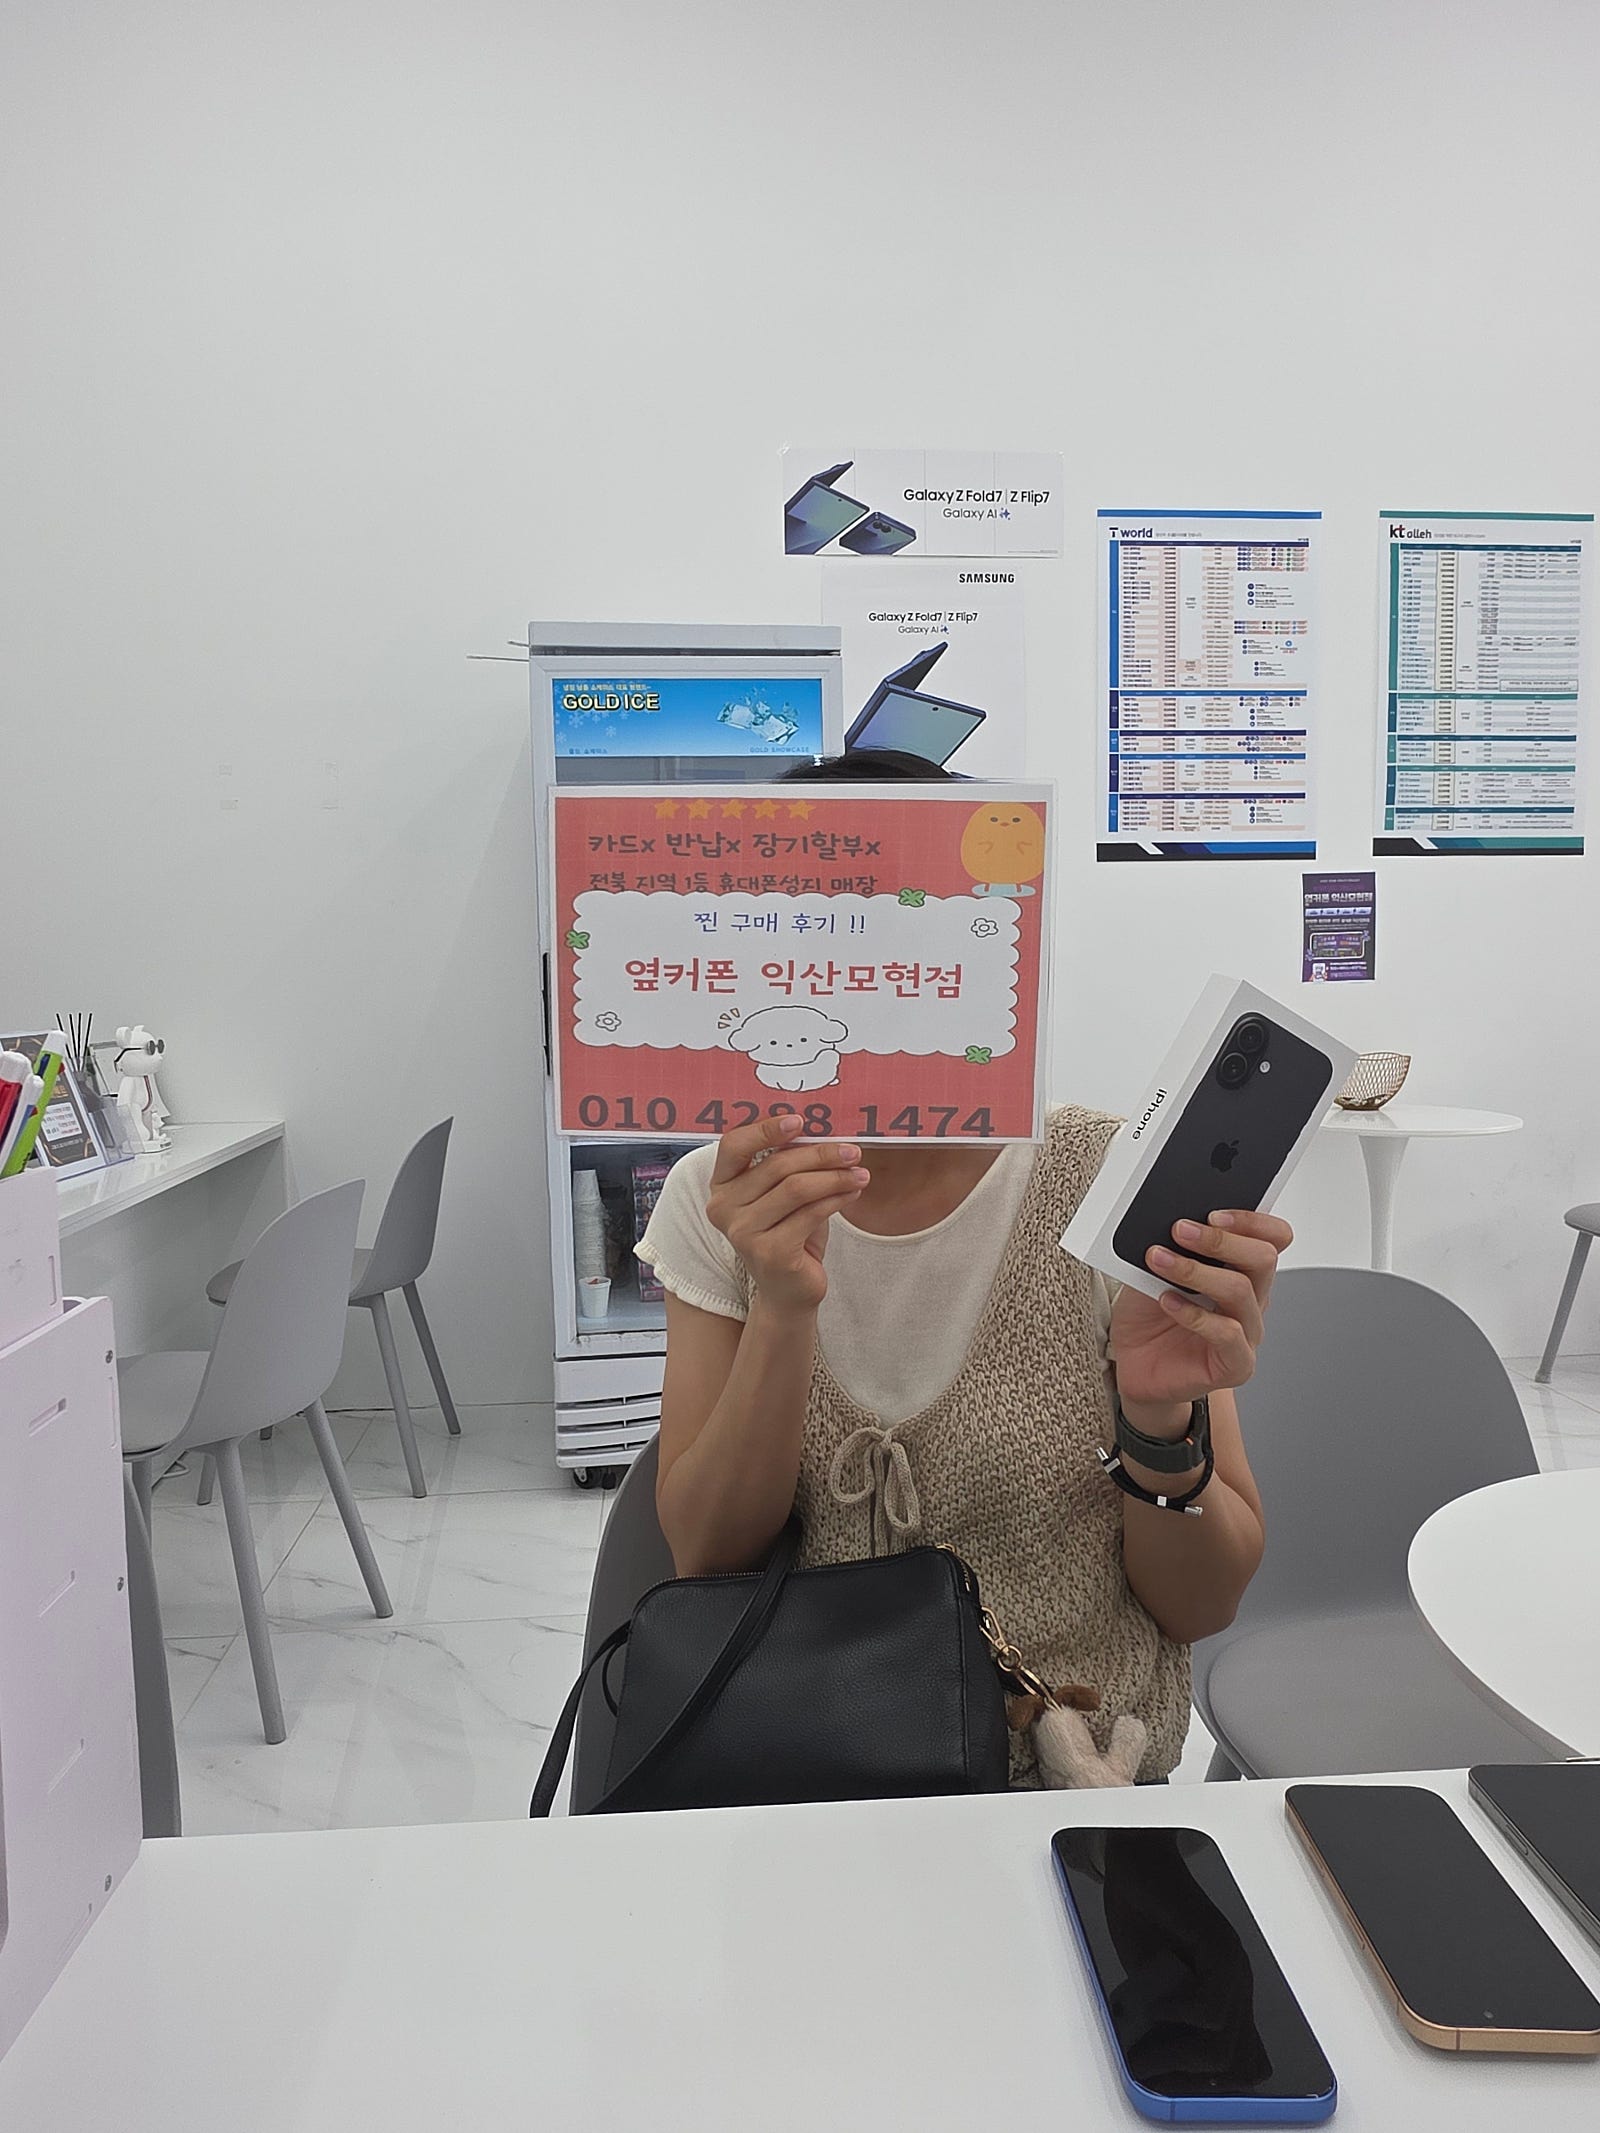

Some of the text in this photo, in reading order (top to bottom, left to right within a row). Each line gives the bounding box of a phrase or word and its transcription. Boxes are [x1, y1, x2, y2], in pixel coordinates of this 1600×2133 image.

[903, 489, 1050, 506] Galaxy Z Fold7 Z Flip7
[943, 508, 997, 521] Galaxy AI
[1109, 527, 1119, 538] T
[1120, 528, 1153, 538] world
[1390, 524, 1405, 539] kt
[1406, 529, 1432, 539] olleh
[959, 573, 1015, 583] SAMSUNG
[868, 611, 978, 624] Galaxy Z Fold7 Z Flip7
[898, 626, 939, 635] Galaxy AI
[635, 873, 677, 892] 지역
[684, 872, 709, 893] 1등
[831, 875, 878, 895] 매장
[693, 911, 866, 934] 찐 구매 후기 !!
[624, 957, 963, 999] 옆커폰 익산모현점
[578, 1095, 677, 1130] 010
[856, 1104, 996, 1138] 1474
[1132, 1088, 1168, 1140] iPhone
